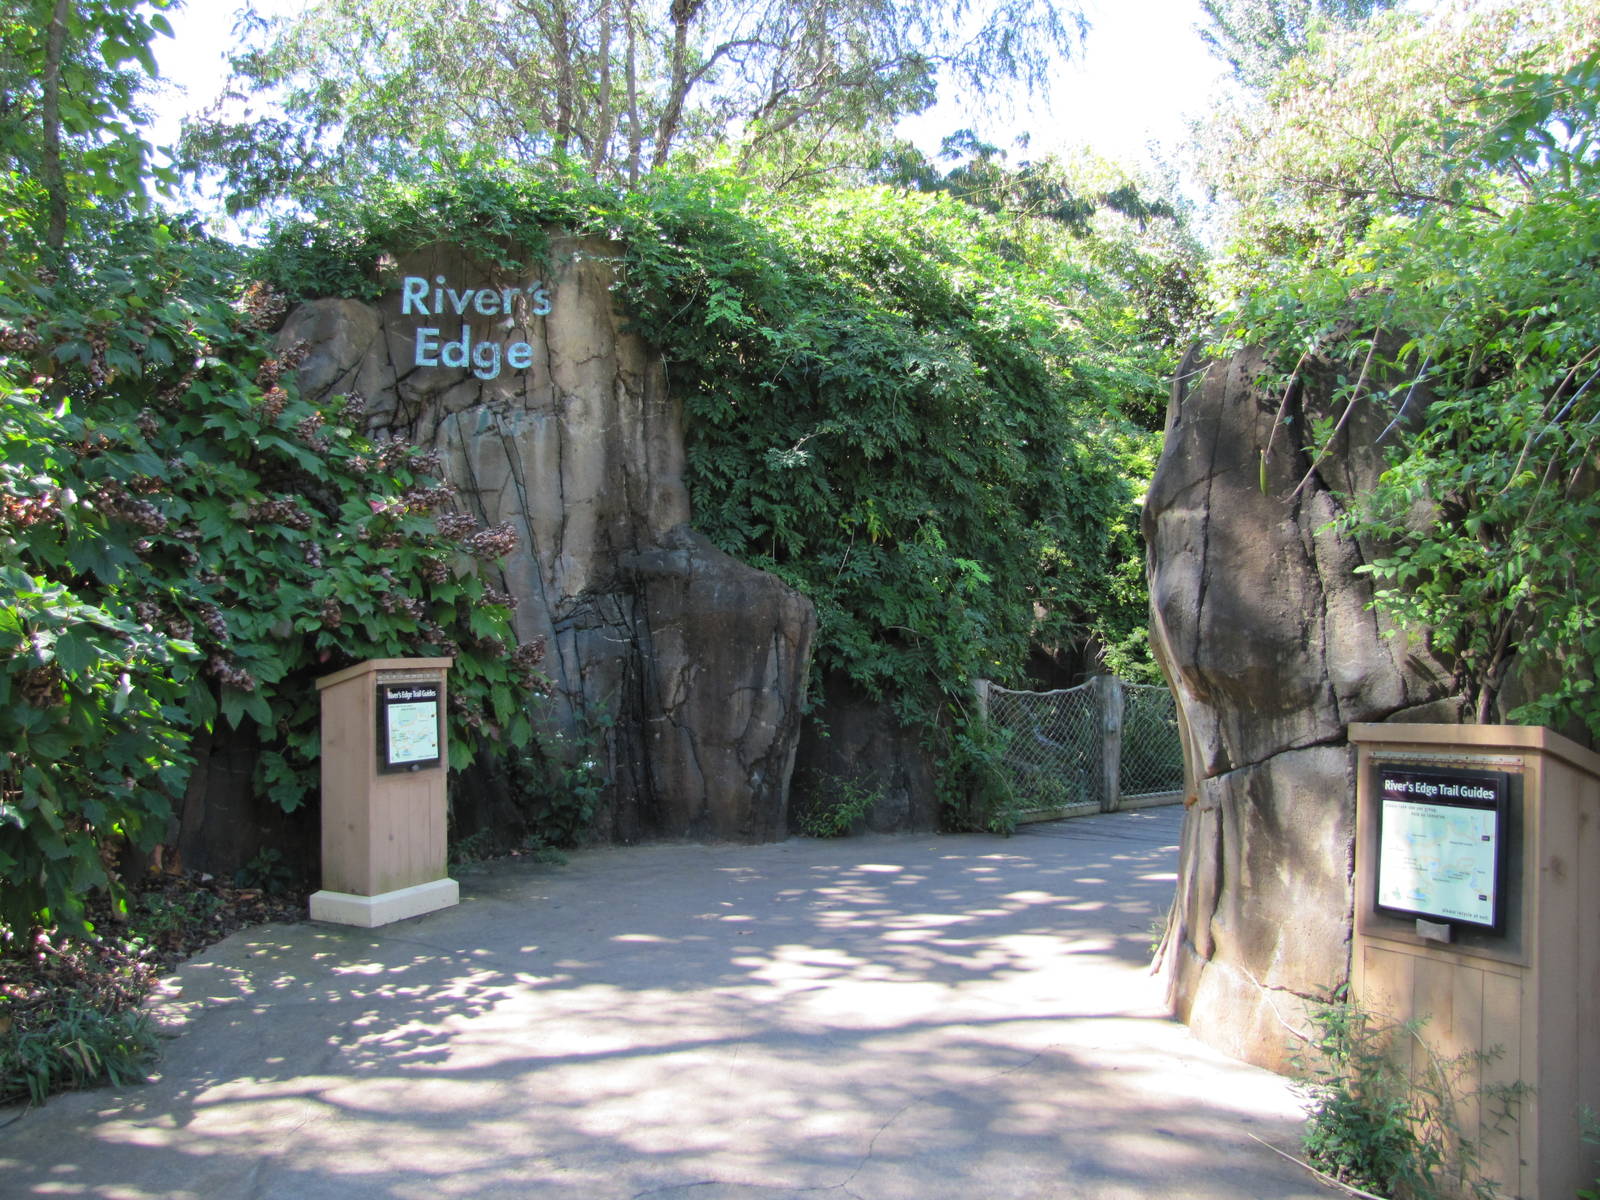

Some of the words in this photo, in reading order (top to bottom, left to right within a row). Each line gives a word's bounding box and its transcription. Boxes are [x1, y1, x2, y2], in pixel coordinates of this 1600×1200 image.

[401, 275, 553, 316] River's
[415, 325, 534, 380] Edge
[1384, 779, 1413, 793] River's
[1415, 782, 1438, 797] Edge
[1439, 784, 1459, 797] Trail
[1460, 786, 1495, 800] Guides
